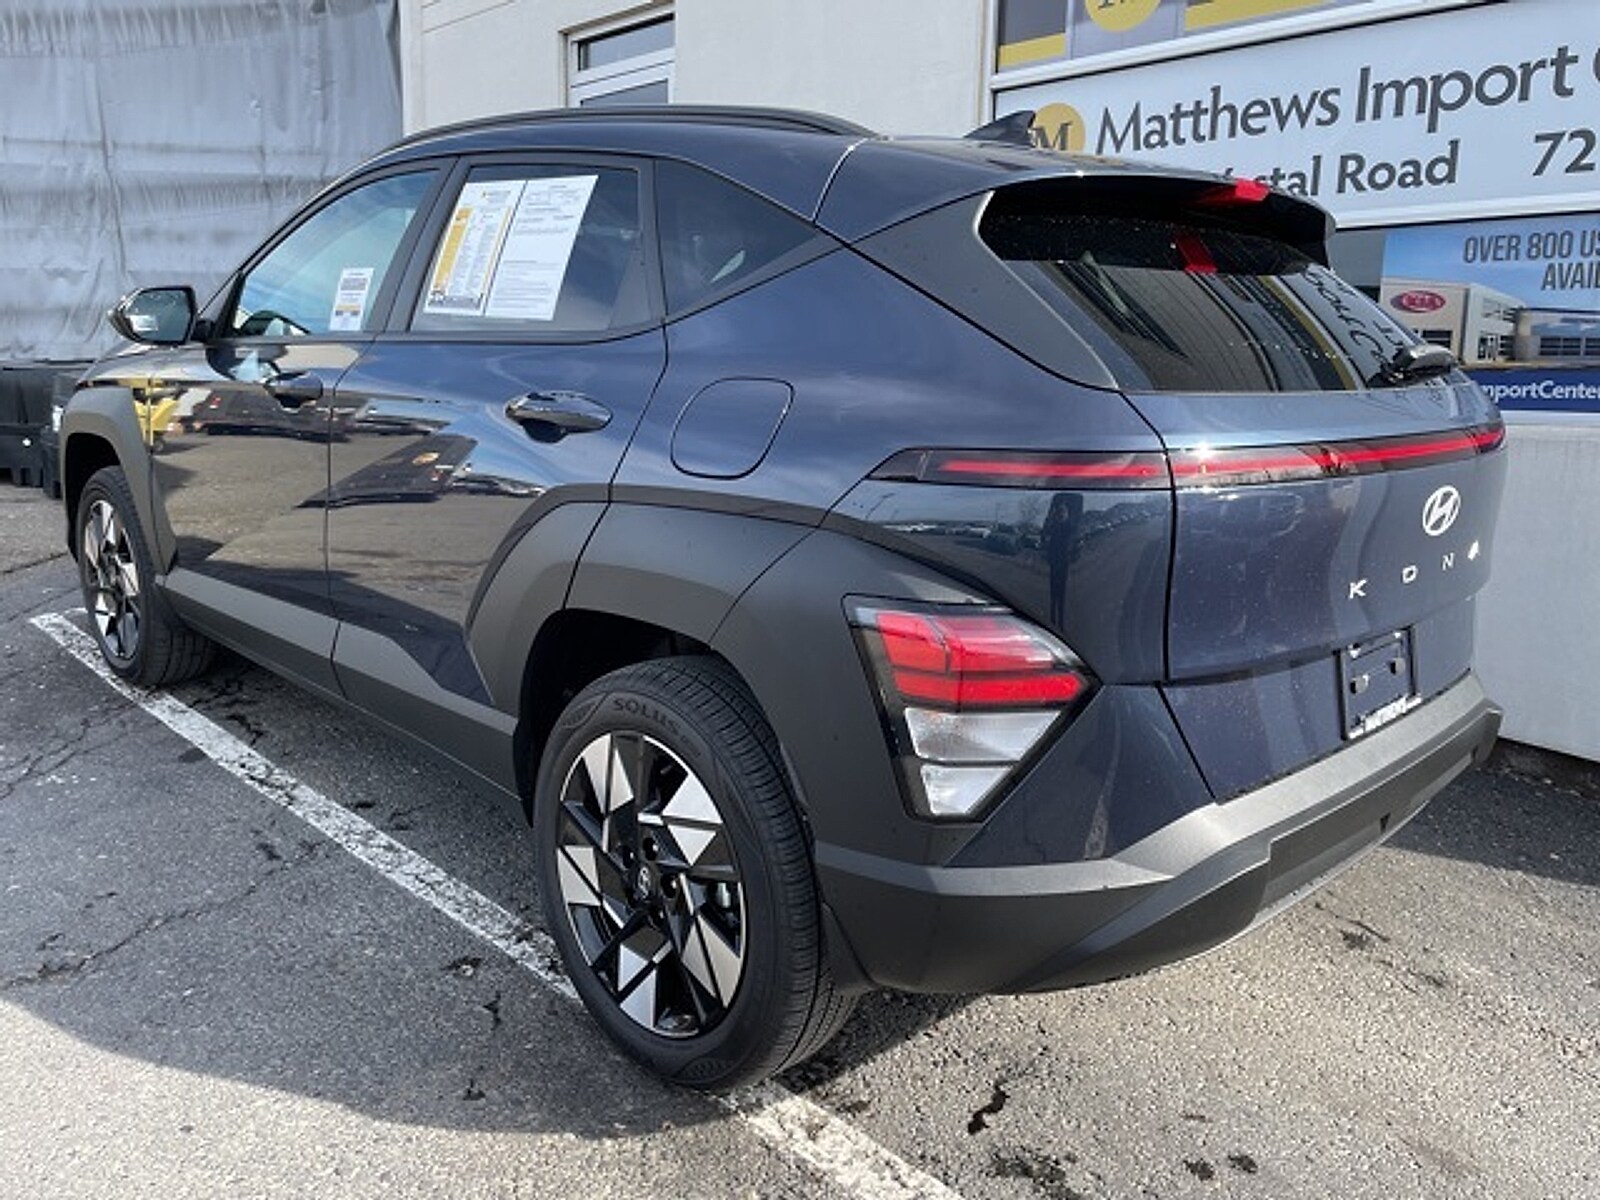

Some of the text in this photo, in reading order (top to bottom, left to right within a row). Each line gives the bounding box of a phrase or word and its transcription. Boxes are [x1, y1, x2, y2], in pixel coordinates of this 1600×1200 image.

[1096, 84, 1342, 155] Matthews
[1355, 45, 1580, 133] Import
[1337, 138, 1460, 194] Road
[1532, 128, 1597, 176] 72
[1463, 234, 1521, 263] OVER
[1526, 230, 1574, 260] 800
